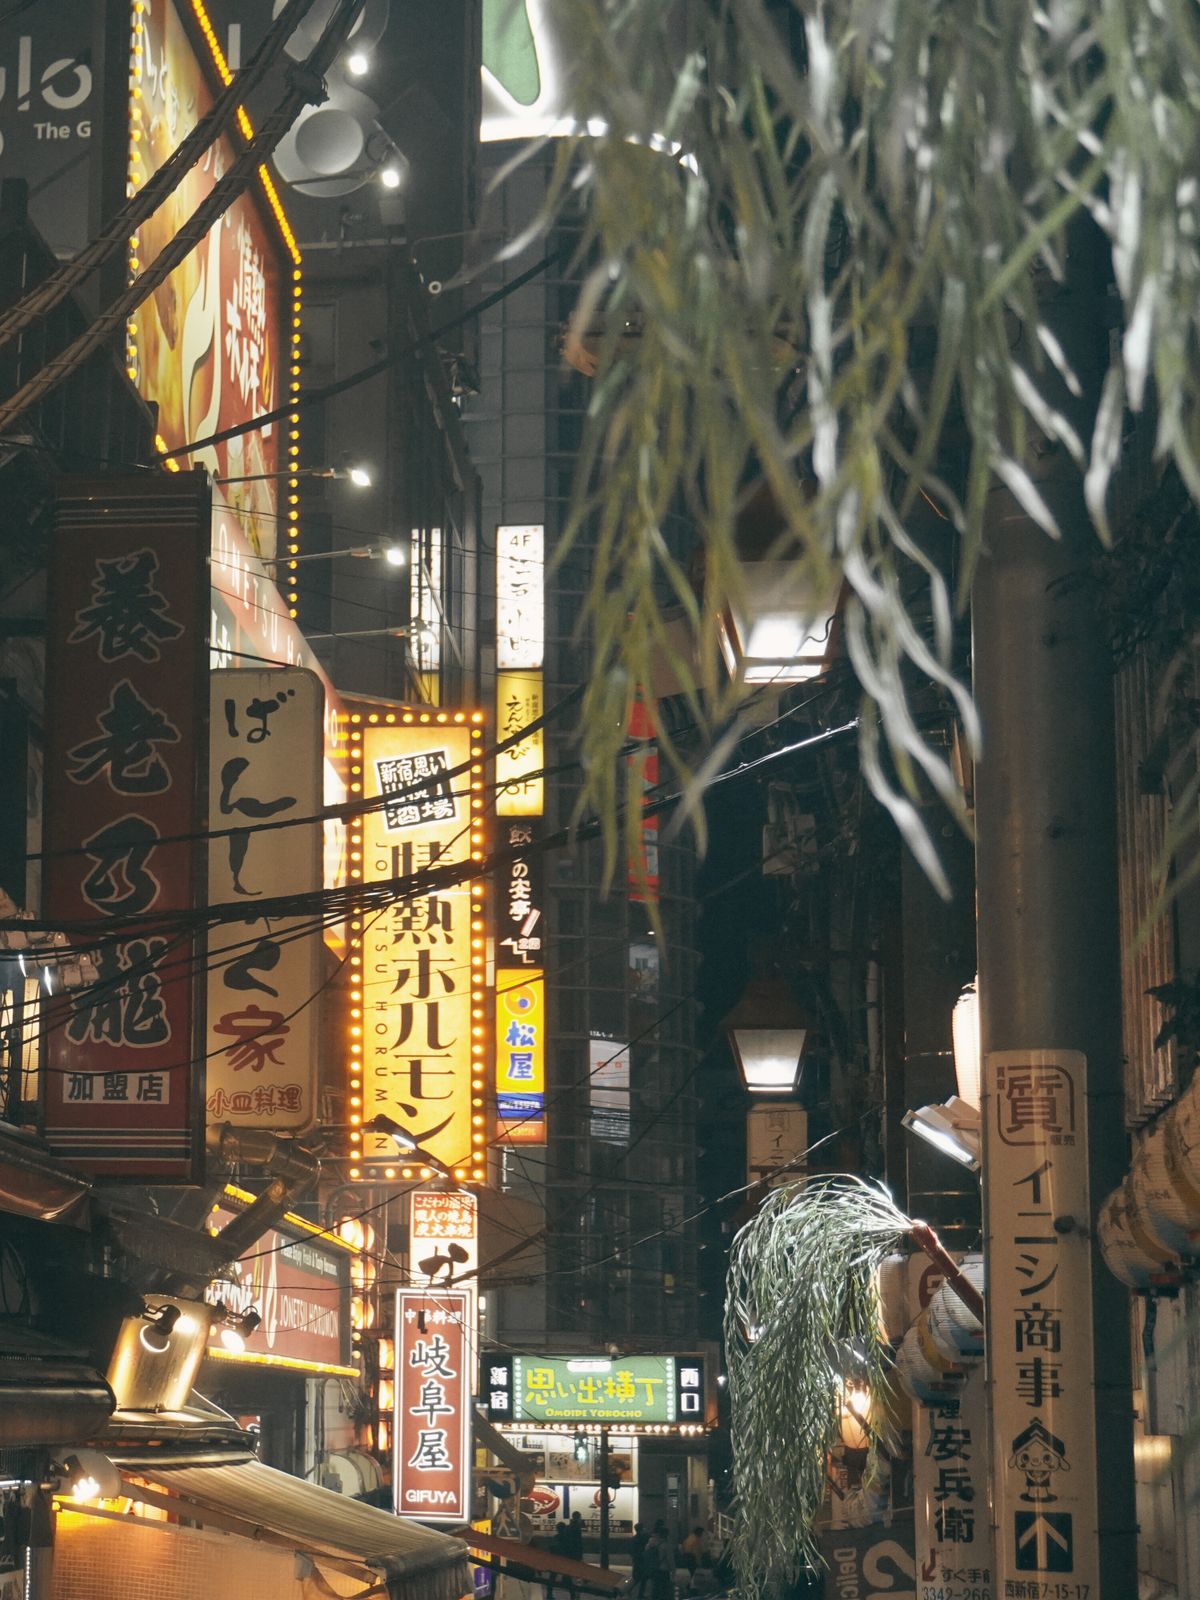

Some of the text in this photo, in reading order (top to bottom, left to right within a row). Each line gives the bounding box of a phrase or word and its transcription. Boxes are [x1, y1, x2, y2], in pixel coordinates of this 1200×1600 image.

[34, 121, 92, 139] The G
[510, 534, 531, 547] 4F
[379, 755, 447, 785] 新宿思い
[387, 798, 454, 827] 酒場
[212, 688, 297, 1072] ばんしく家
[505, 1020, 536, 1080] 松屋
[67, 1072, 165, 1102] 加盟店
[374, 1001, 388, 1150] HORUMN
[206, 1084, 303, 1113] 小皿料理
[1006, 1073, 1064, 1134] 質
[1011, 1158, 1065, 1408] イニシ商事
[408, 1335, 455, 1474] 岐阜屋
[490, 1366, 508, 1410] 新宿
[525, 1367, 663, 1406] 思い出横丁
[680, 1368, 700, 1412] 西口
[405, 1488, 457, 1504] GIFUYA
[1005, 1579, 1091, 1600] 西新宿7-15-17
